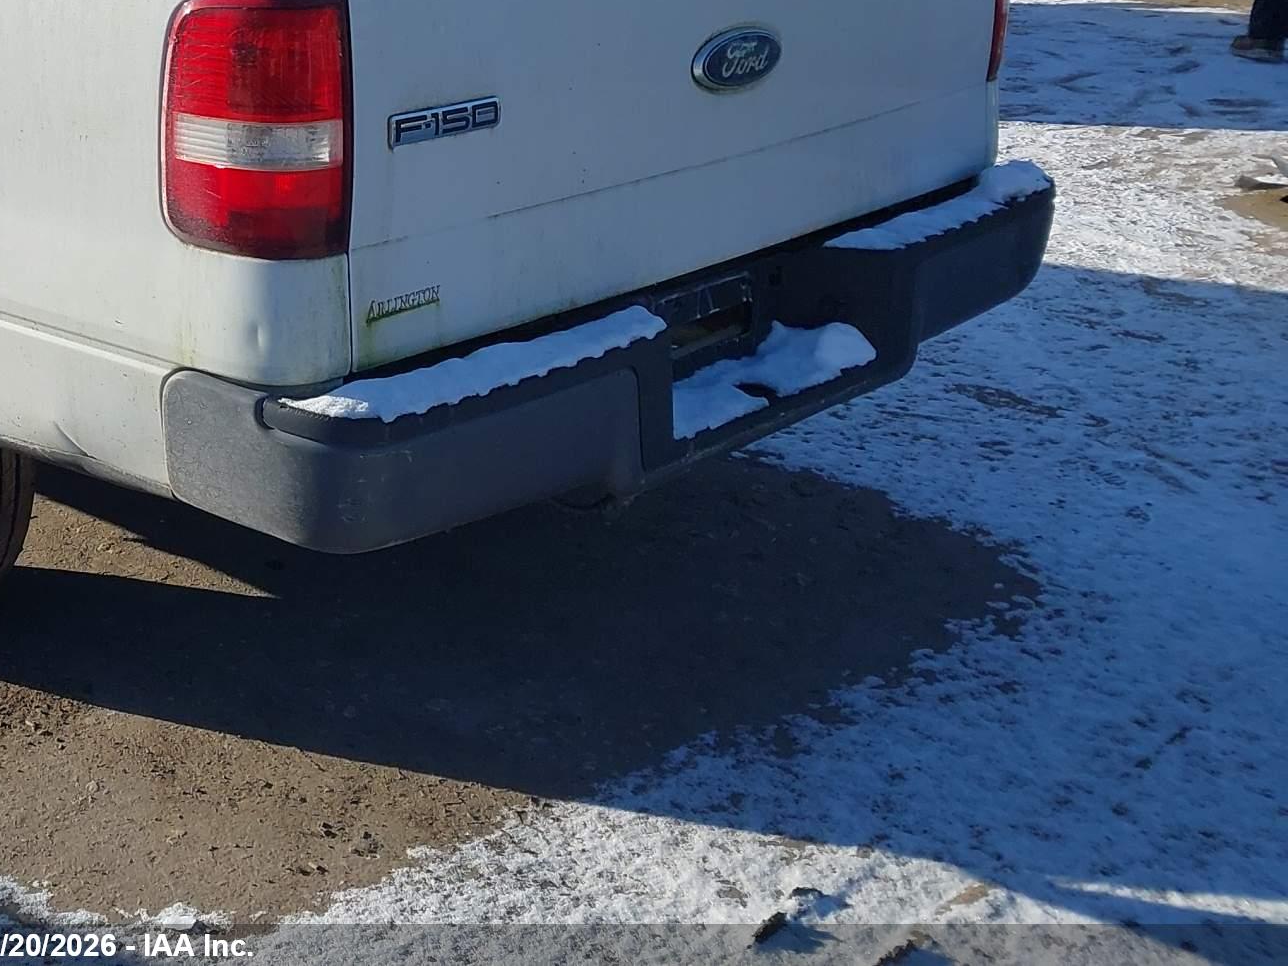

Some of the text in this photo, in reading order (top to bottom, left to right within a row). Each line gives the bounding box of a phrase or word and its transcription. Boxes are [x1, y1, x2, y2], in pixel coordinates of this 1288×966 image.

[722, 40, 770, 78] Ford
[395, 100, 499, 143] F-150
[366, 284, 441, 324] ARLINGTON
